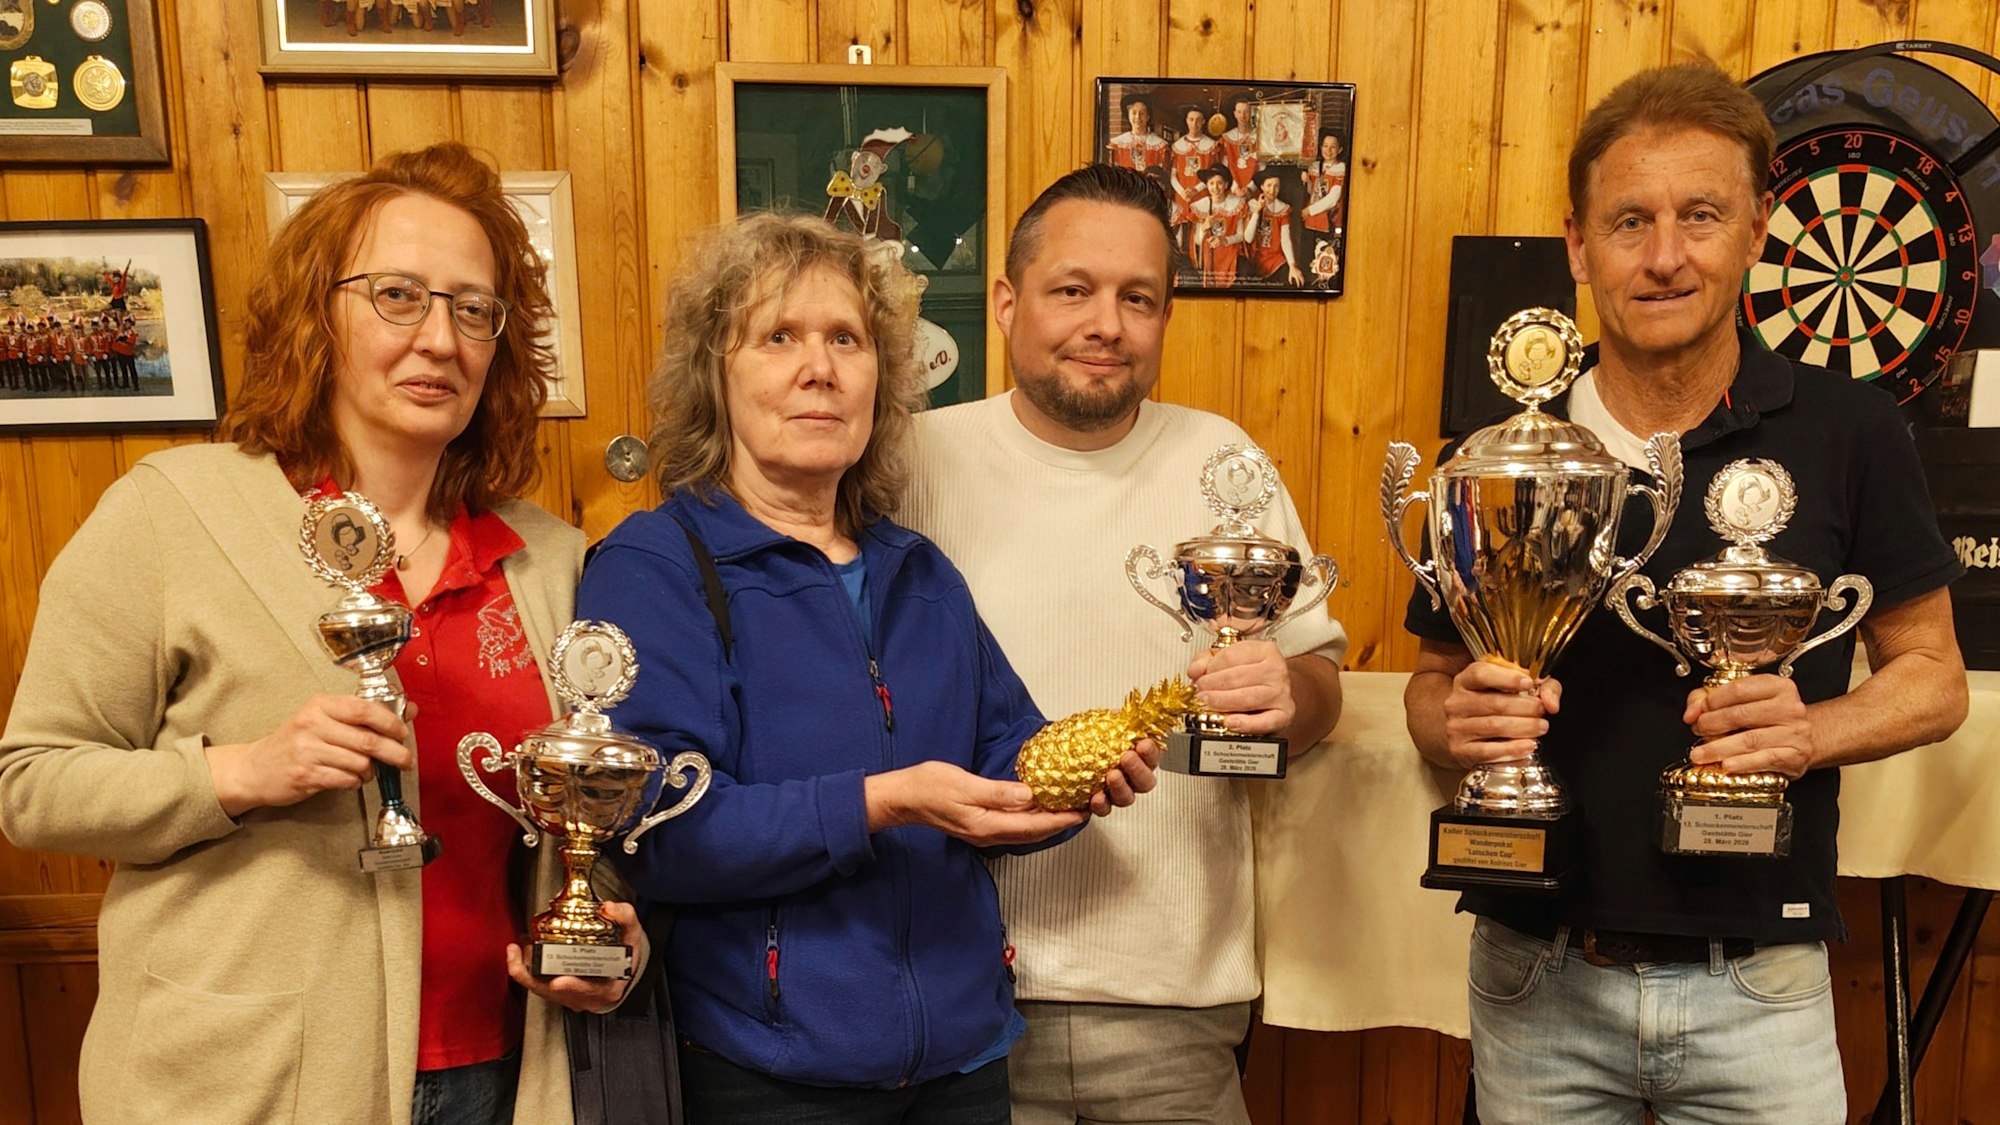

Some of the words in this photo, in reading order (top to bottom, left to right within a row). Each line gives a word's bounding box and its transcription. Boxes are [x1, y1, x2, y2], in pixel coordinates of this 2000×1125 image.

[1810, 140, 1820, 156] 5
[1844, 133, 1862, 149] 20
[1888, 140, 1898, 154] 1
[1769, 160, 1788, 178] 12
[1916, 156, 1934, 176] 18
[1944, 191, 1958, 202] 4
[1958, 223, 1973, 244] 13
[1954, 308, 1970, 326] 10
[1934, 345, 1952, 364] 15
[1910, 378, 1921, 393] 2
[1951, 535, 2000, 569] Rei
